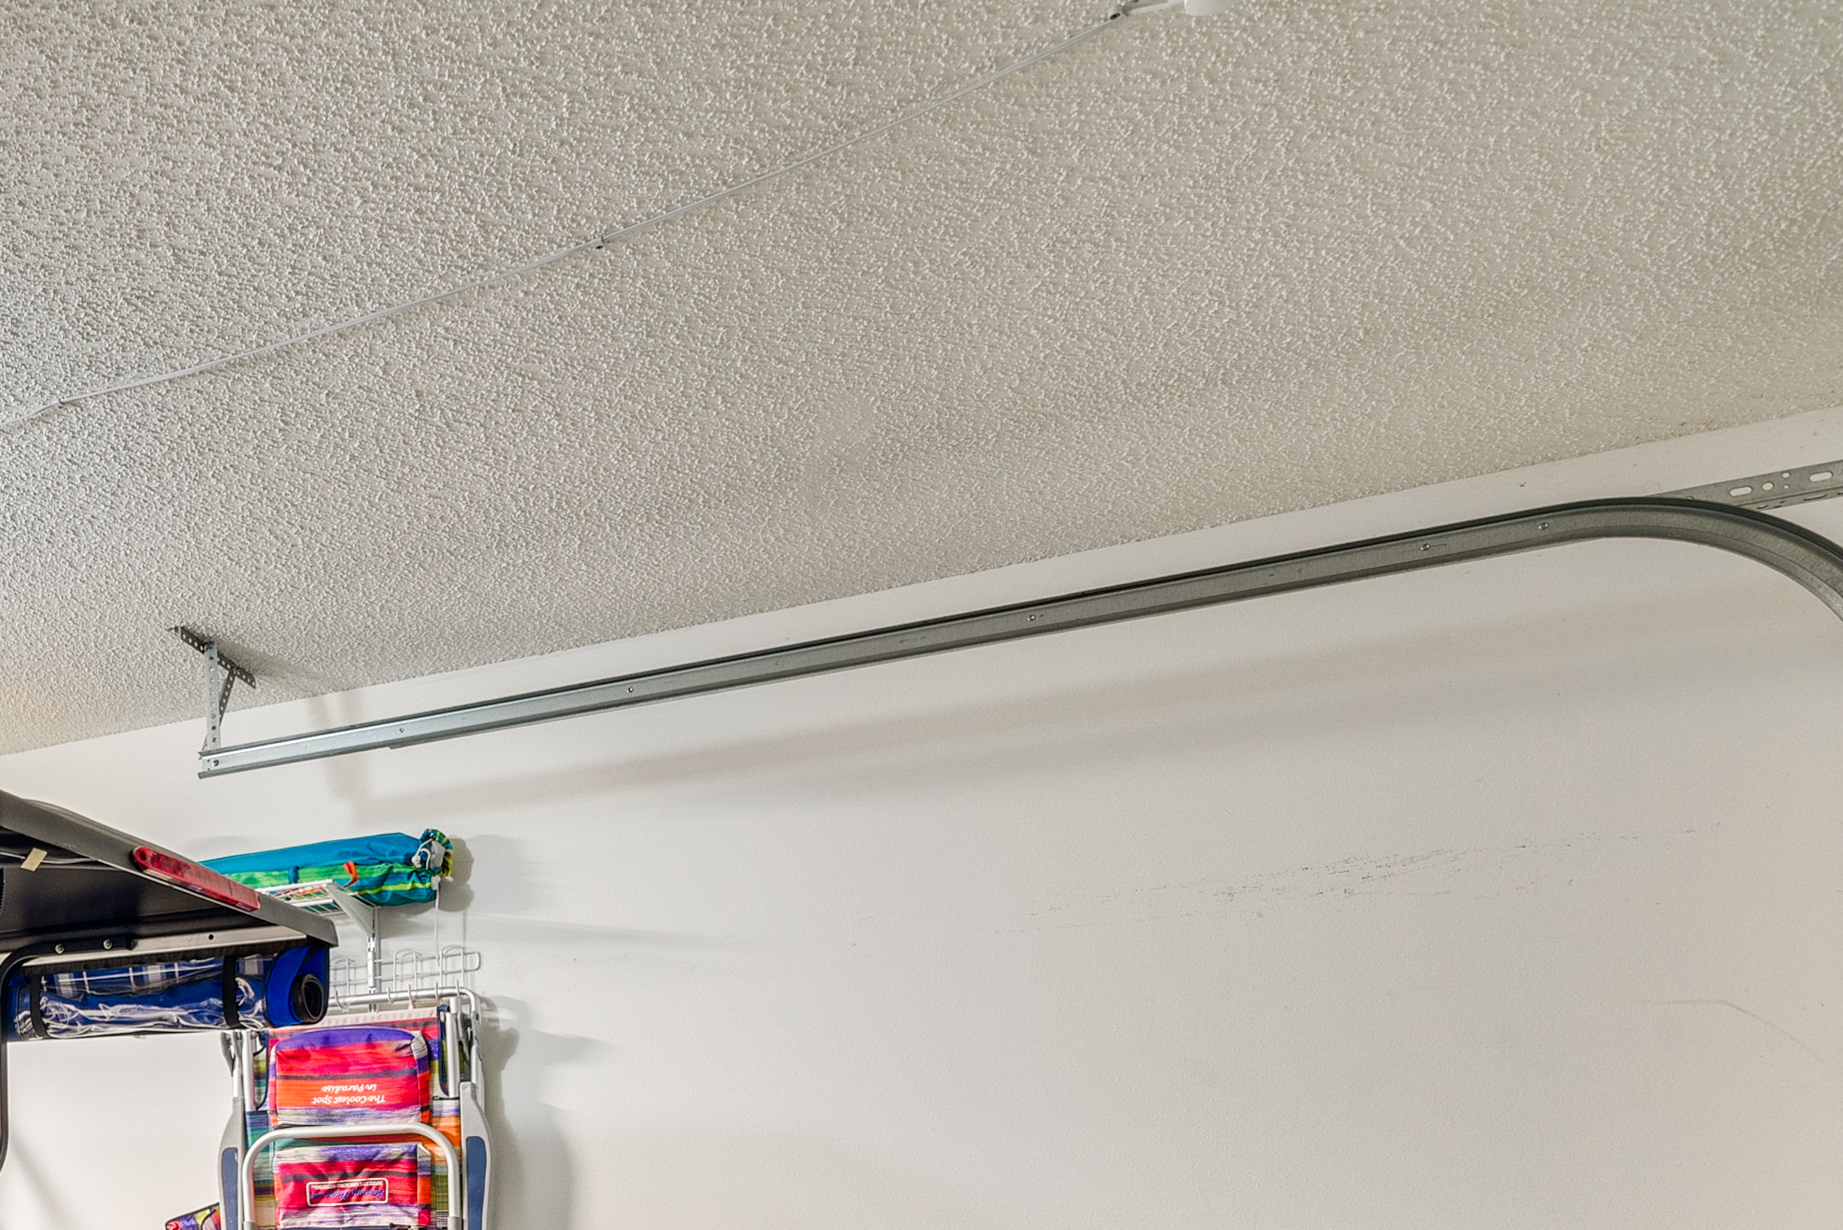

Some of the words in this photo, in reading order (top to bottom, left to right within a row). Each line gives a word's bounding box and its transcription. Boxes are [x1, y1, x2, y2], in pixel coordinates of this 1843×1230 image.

[321, 1084, 365, 1094] Paradise
[311, 1094, 333, 1105] Spot
[333, 1095, 366, 1104] Coolest
[367, 1094, 385, 1104] The
